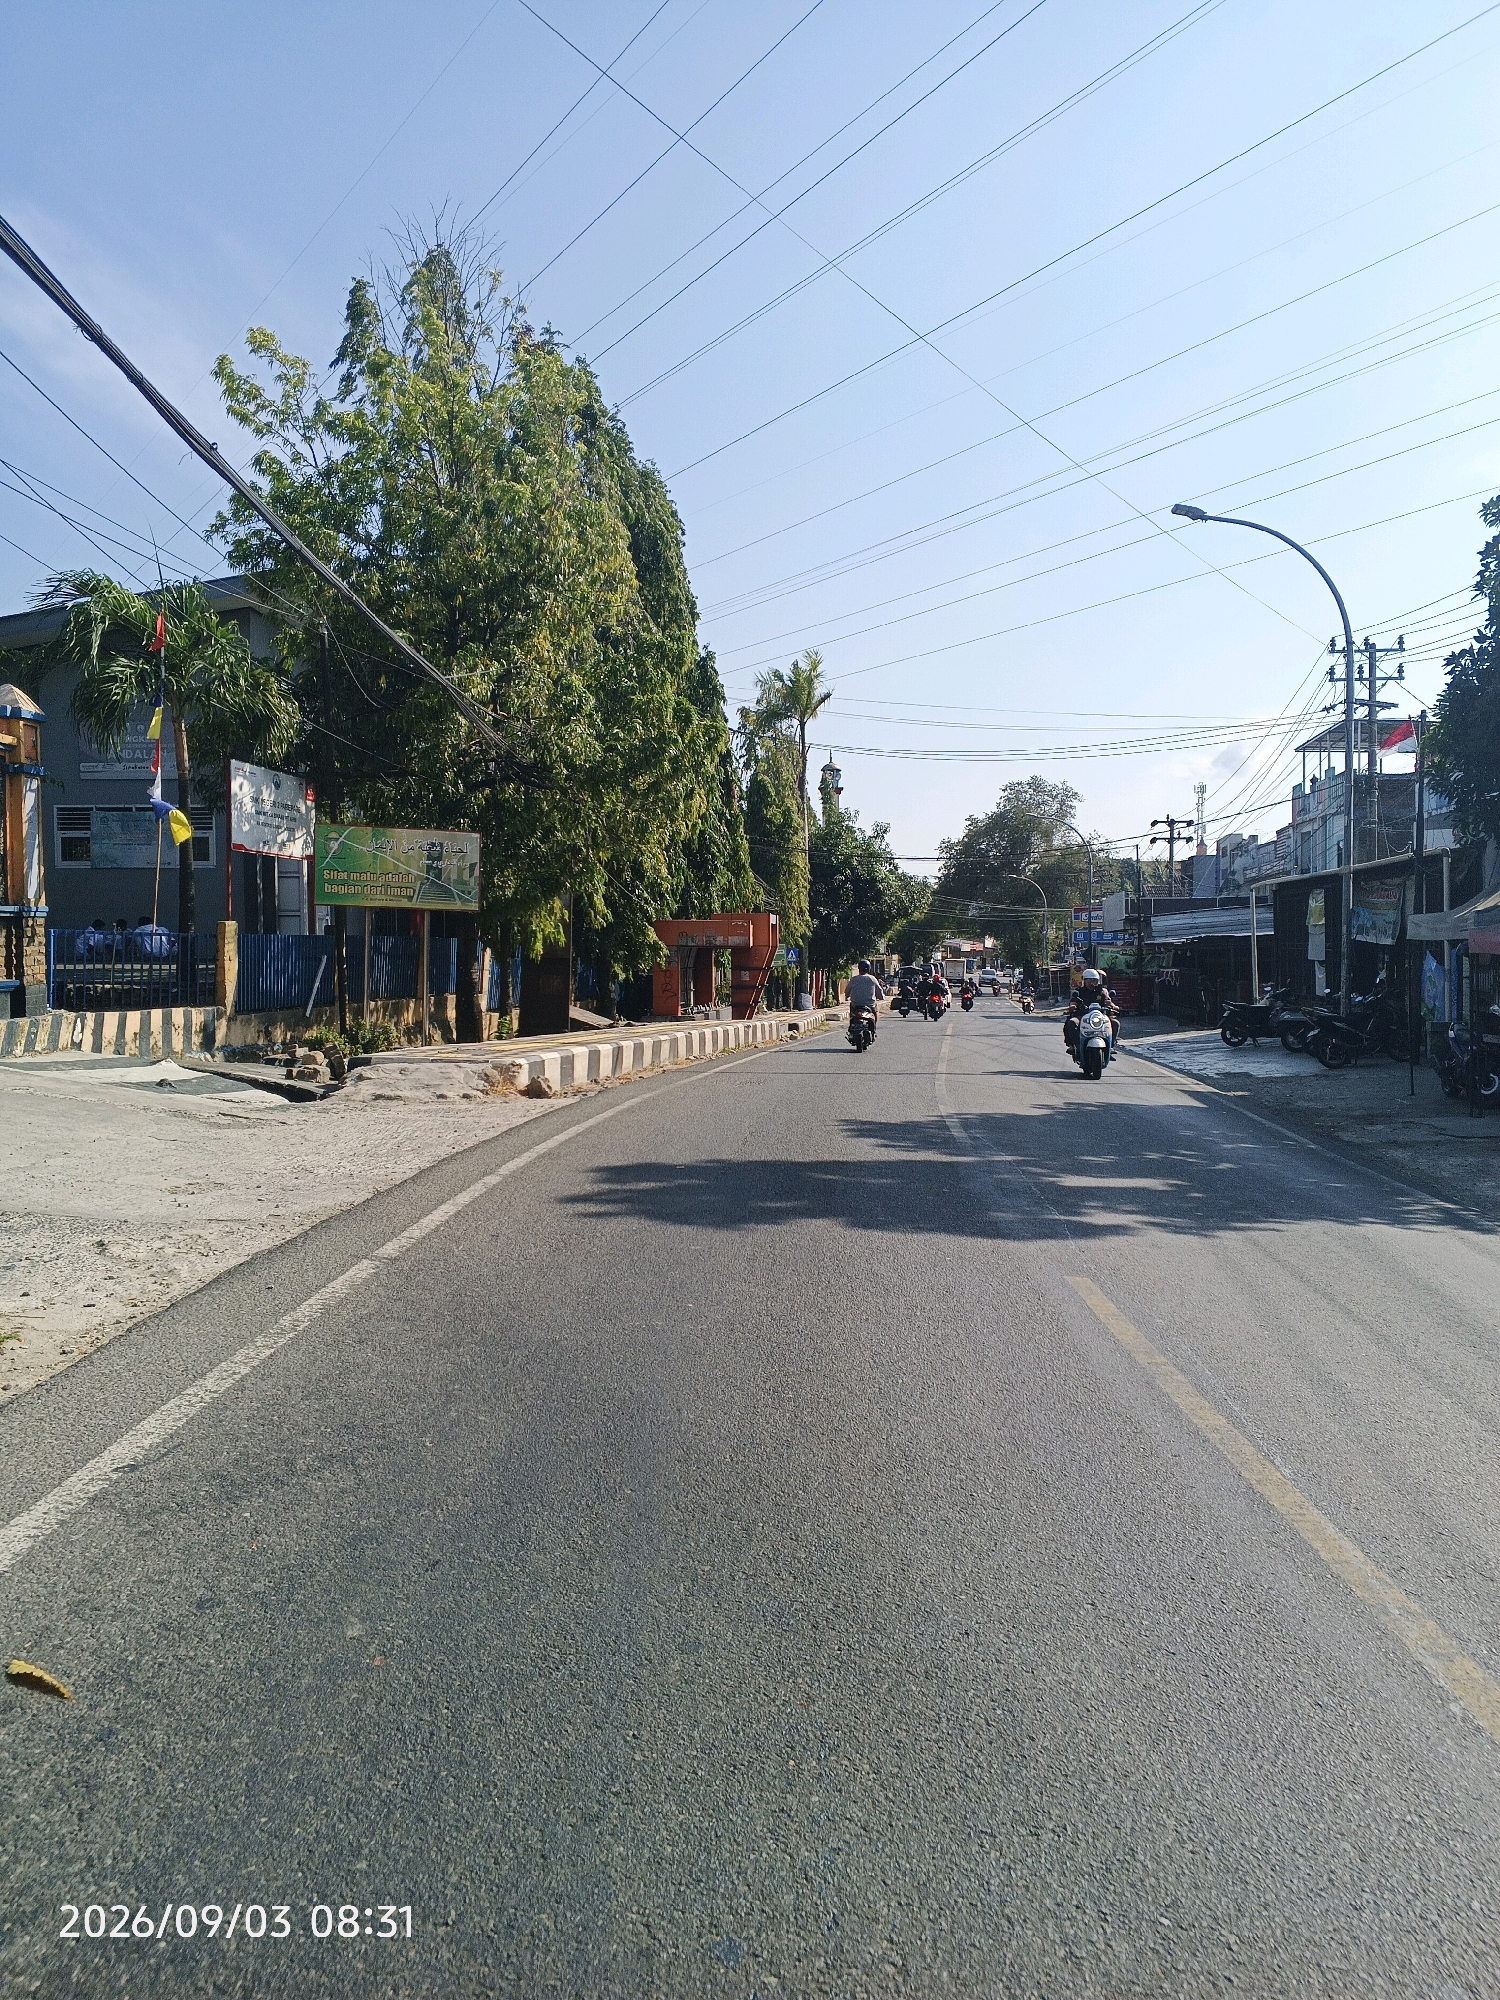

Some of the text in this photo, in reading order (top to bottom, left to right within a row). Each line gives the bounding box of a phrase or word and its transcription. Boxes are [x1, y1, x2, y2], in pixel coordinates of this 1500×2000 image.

[113, 735, 156, 743] BNGKEL
[323, 869, 415, 883] Sifat malu adalah
[324, 882, 414, 896] bagian dari iman
